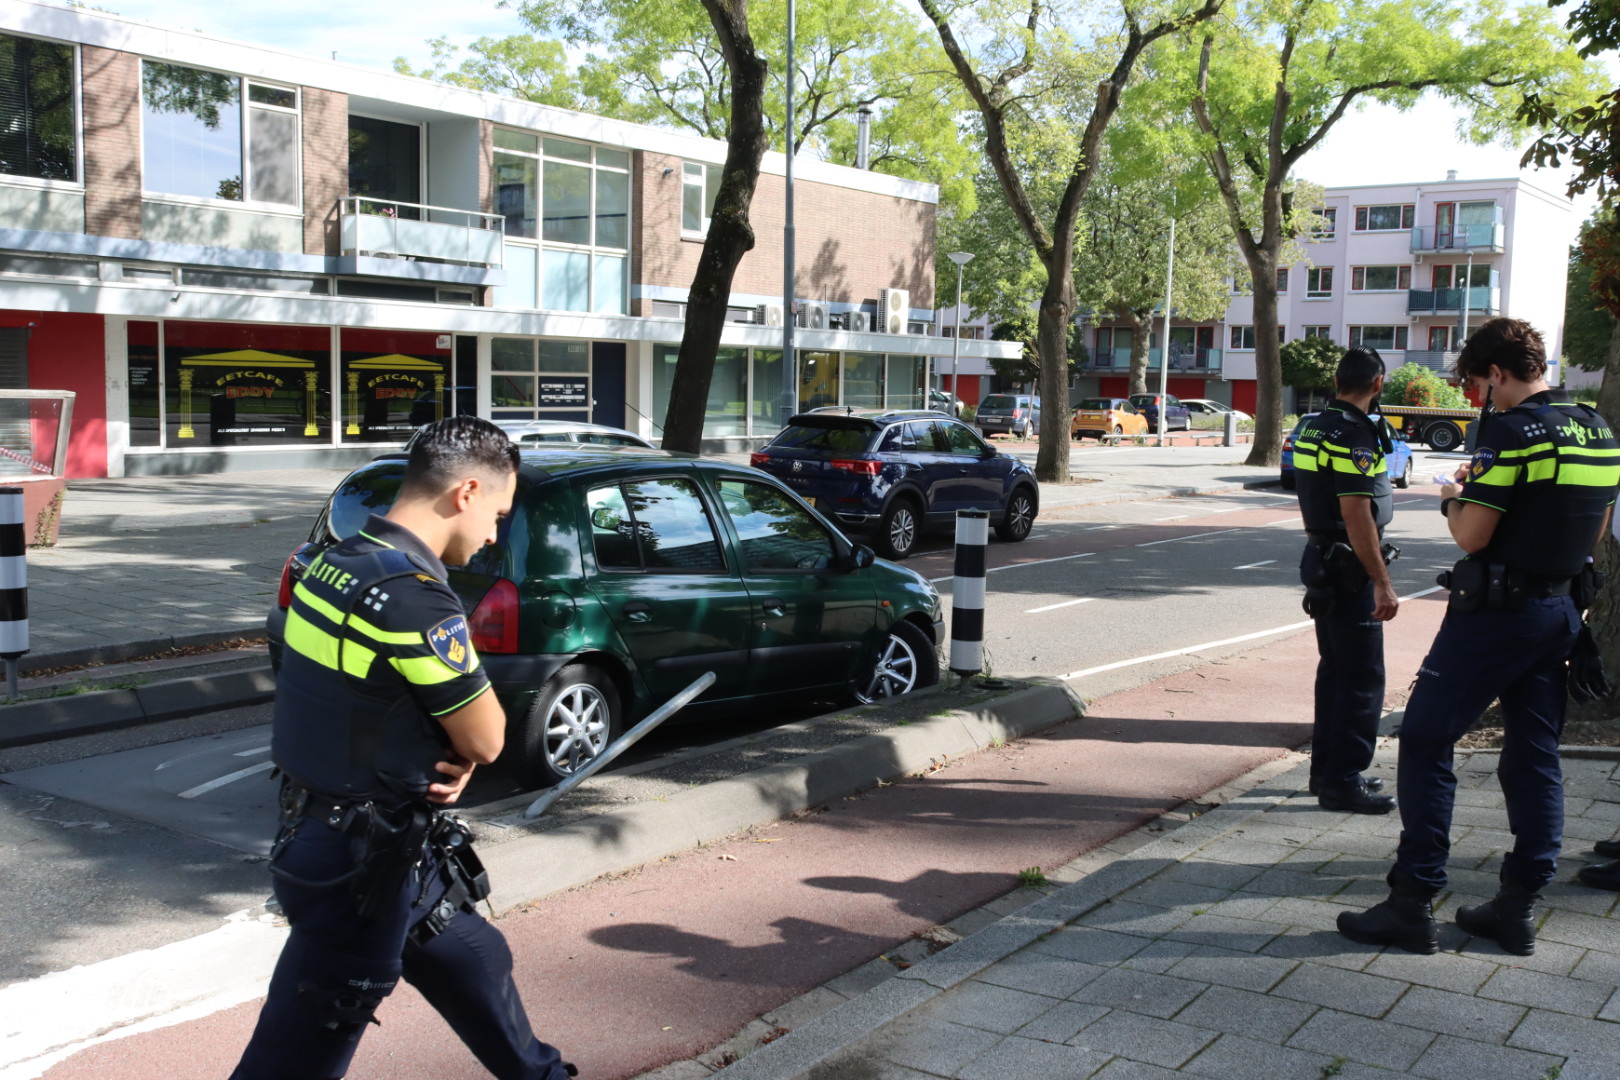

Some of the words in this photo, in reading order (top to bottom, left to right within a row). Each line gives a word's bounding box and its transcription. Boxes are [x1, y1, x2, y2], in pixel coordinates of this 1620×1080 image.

[216, 371, 284, 387] EETCAFE
[368, 373, 425, 388] EETCAFE
[226, 386, 275, 399] EDDY
[375, 387, 417, 399] EDDY
